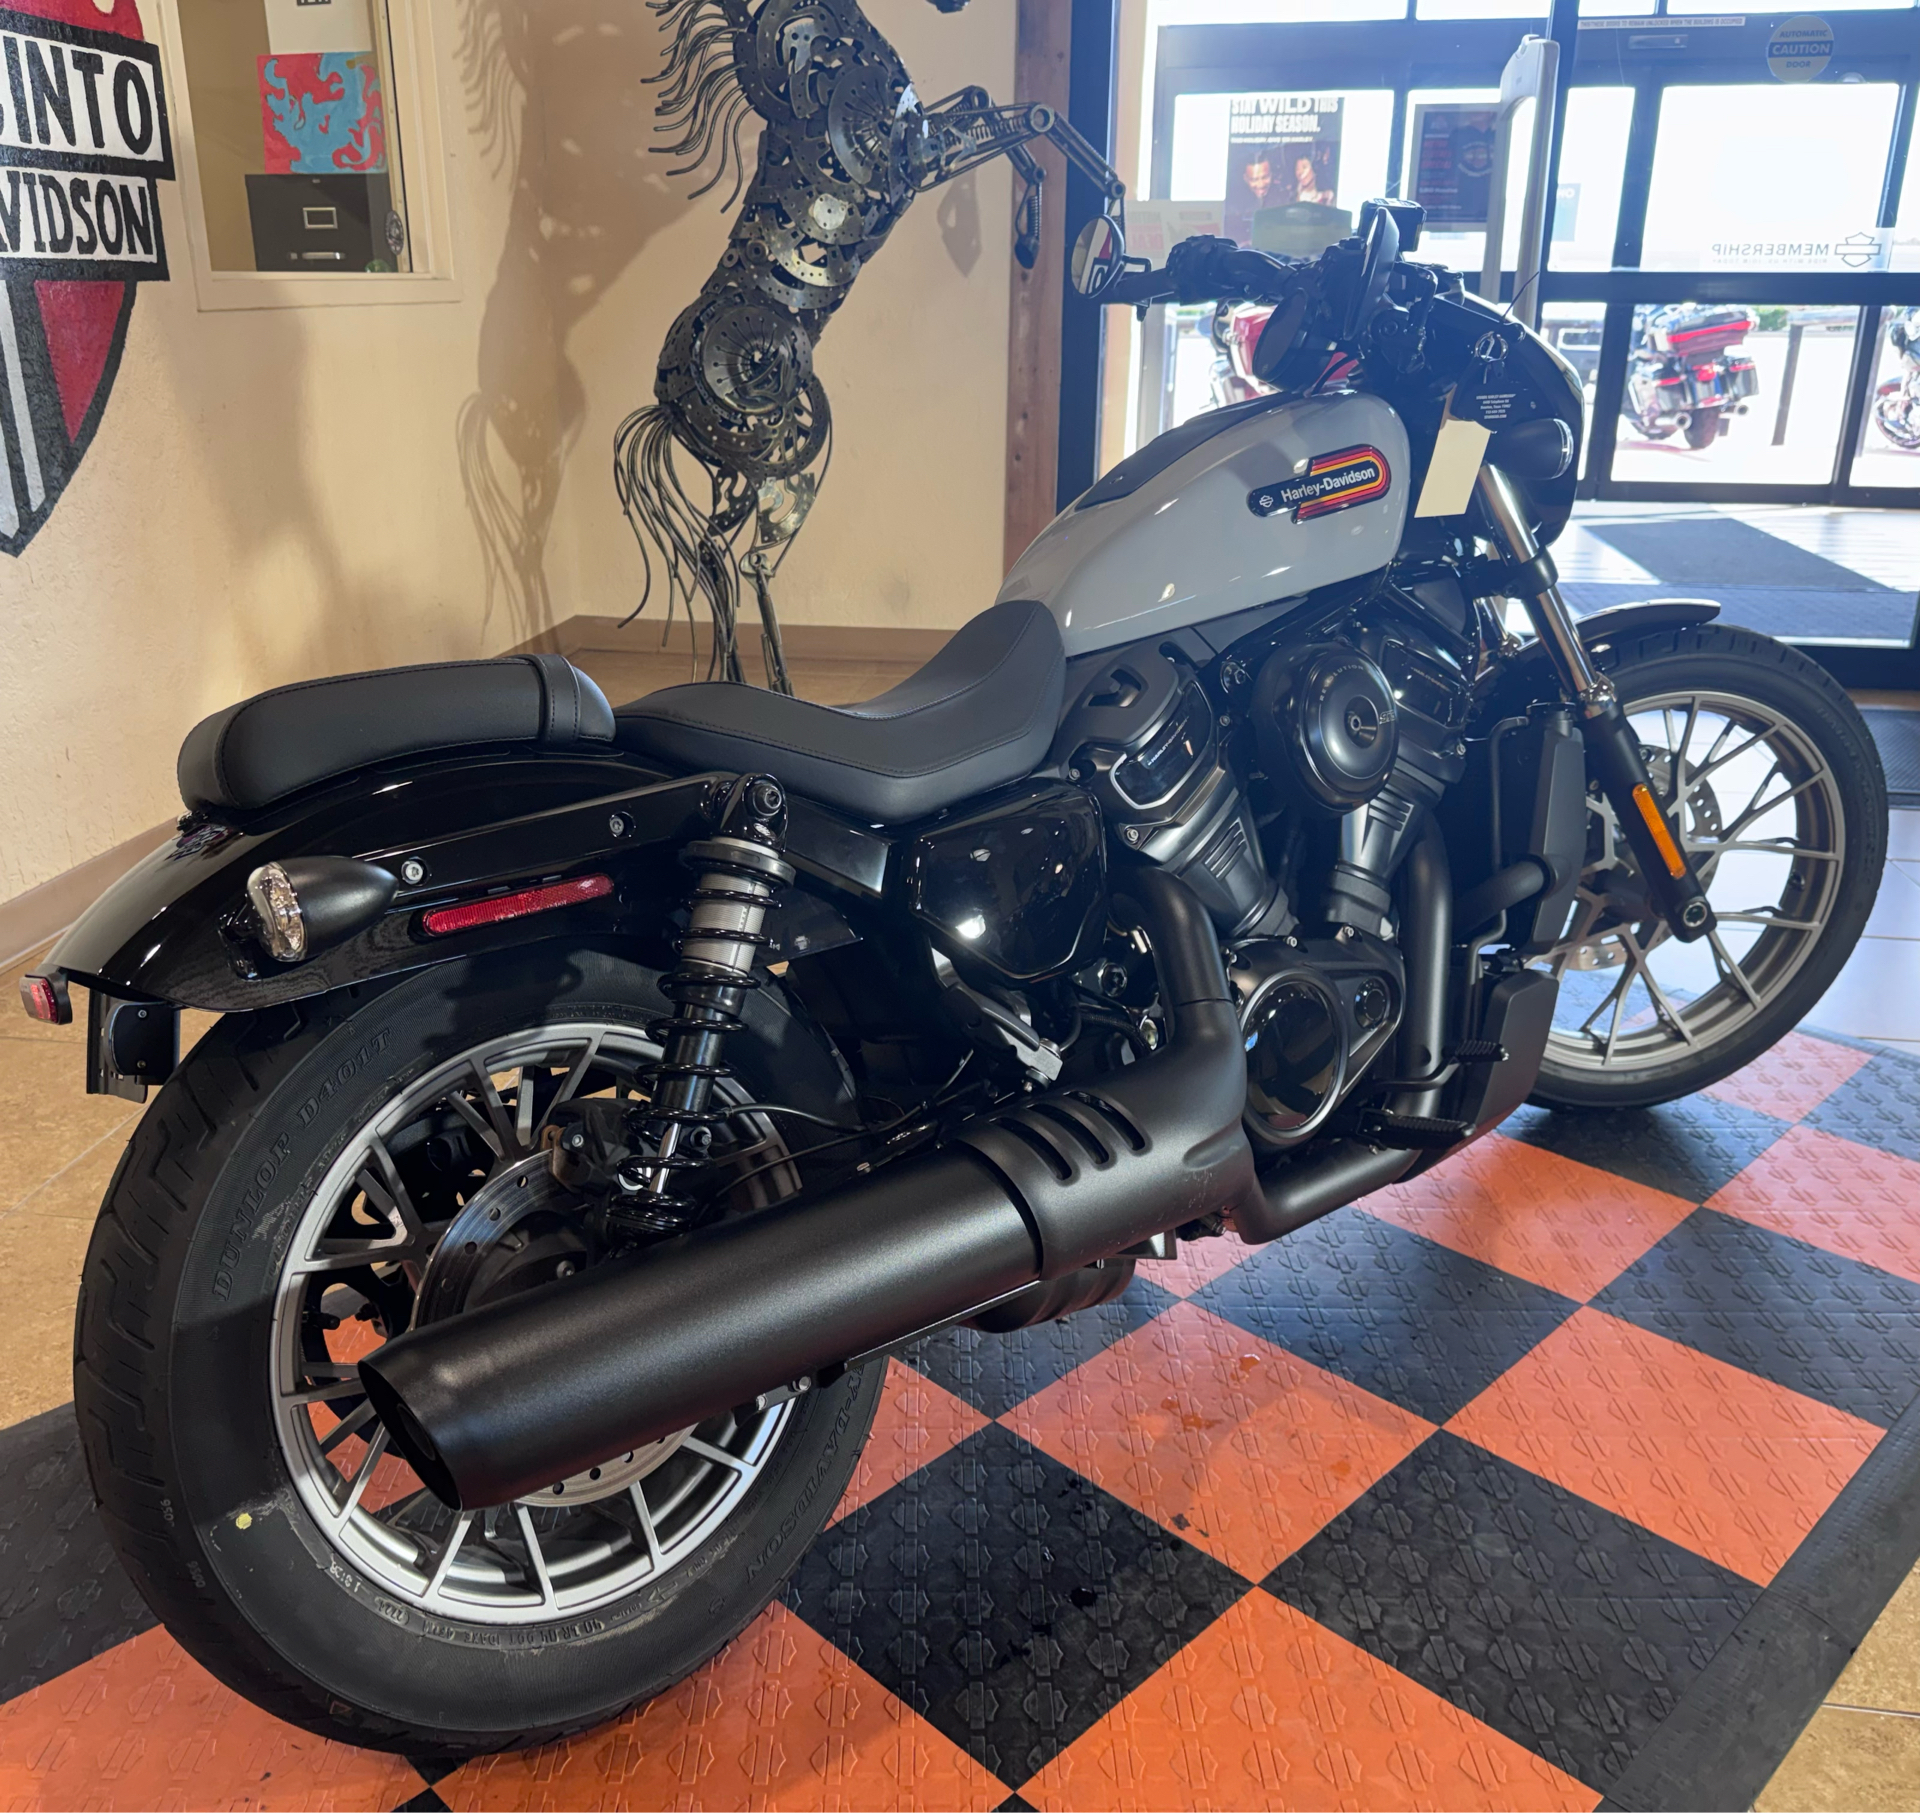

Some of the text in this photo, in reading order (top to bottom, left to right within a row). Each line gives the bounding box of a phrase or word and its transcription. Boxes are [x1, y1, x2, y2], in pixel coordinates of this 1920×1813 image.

[1780, 29, 1828, 38] AUTOMATIC
[1772, 43, 1831, 56] CAUTION
[1786, 60, 1811, 68] DOOR
[0, 35, 153, 155] INTO
[1259, 98, 1312, 114] WILD
[1231, 115, 1275, 133] HOLIDAY
[1280, 467, 1376, 503] Harley-Davidson
[1319, 664, 1364, 702] REVOLUTION
[212, 1132, 289, 1302] DUNLOP
[296, 1028, 391, 1127] D401T
